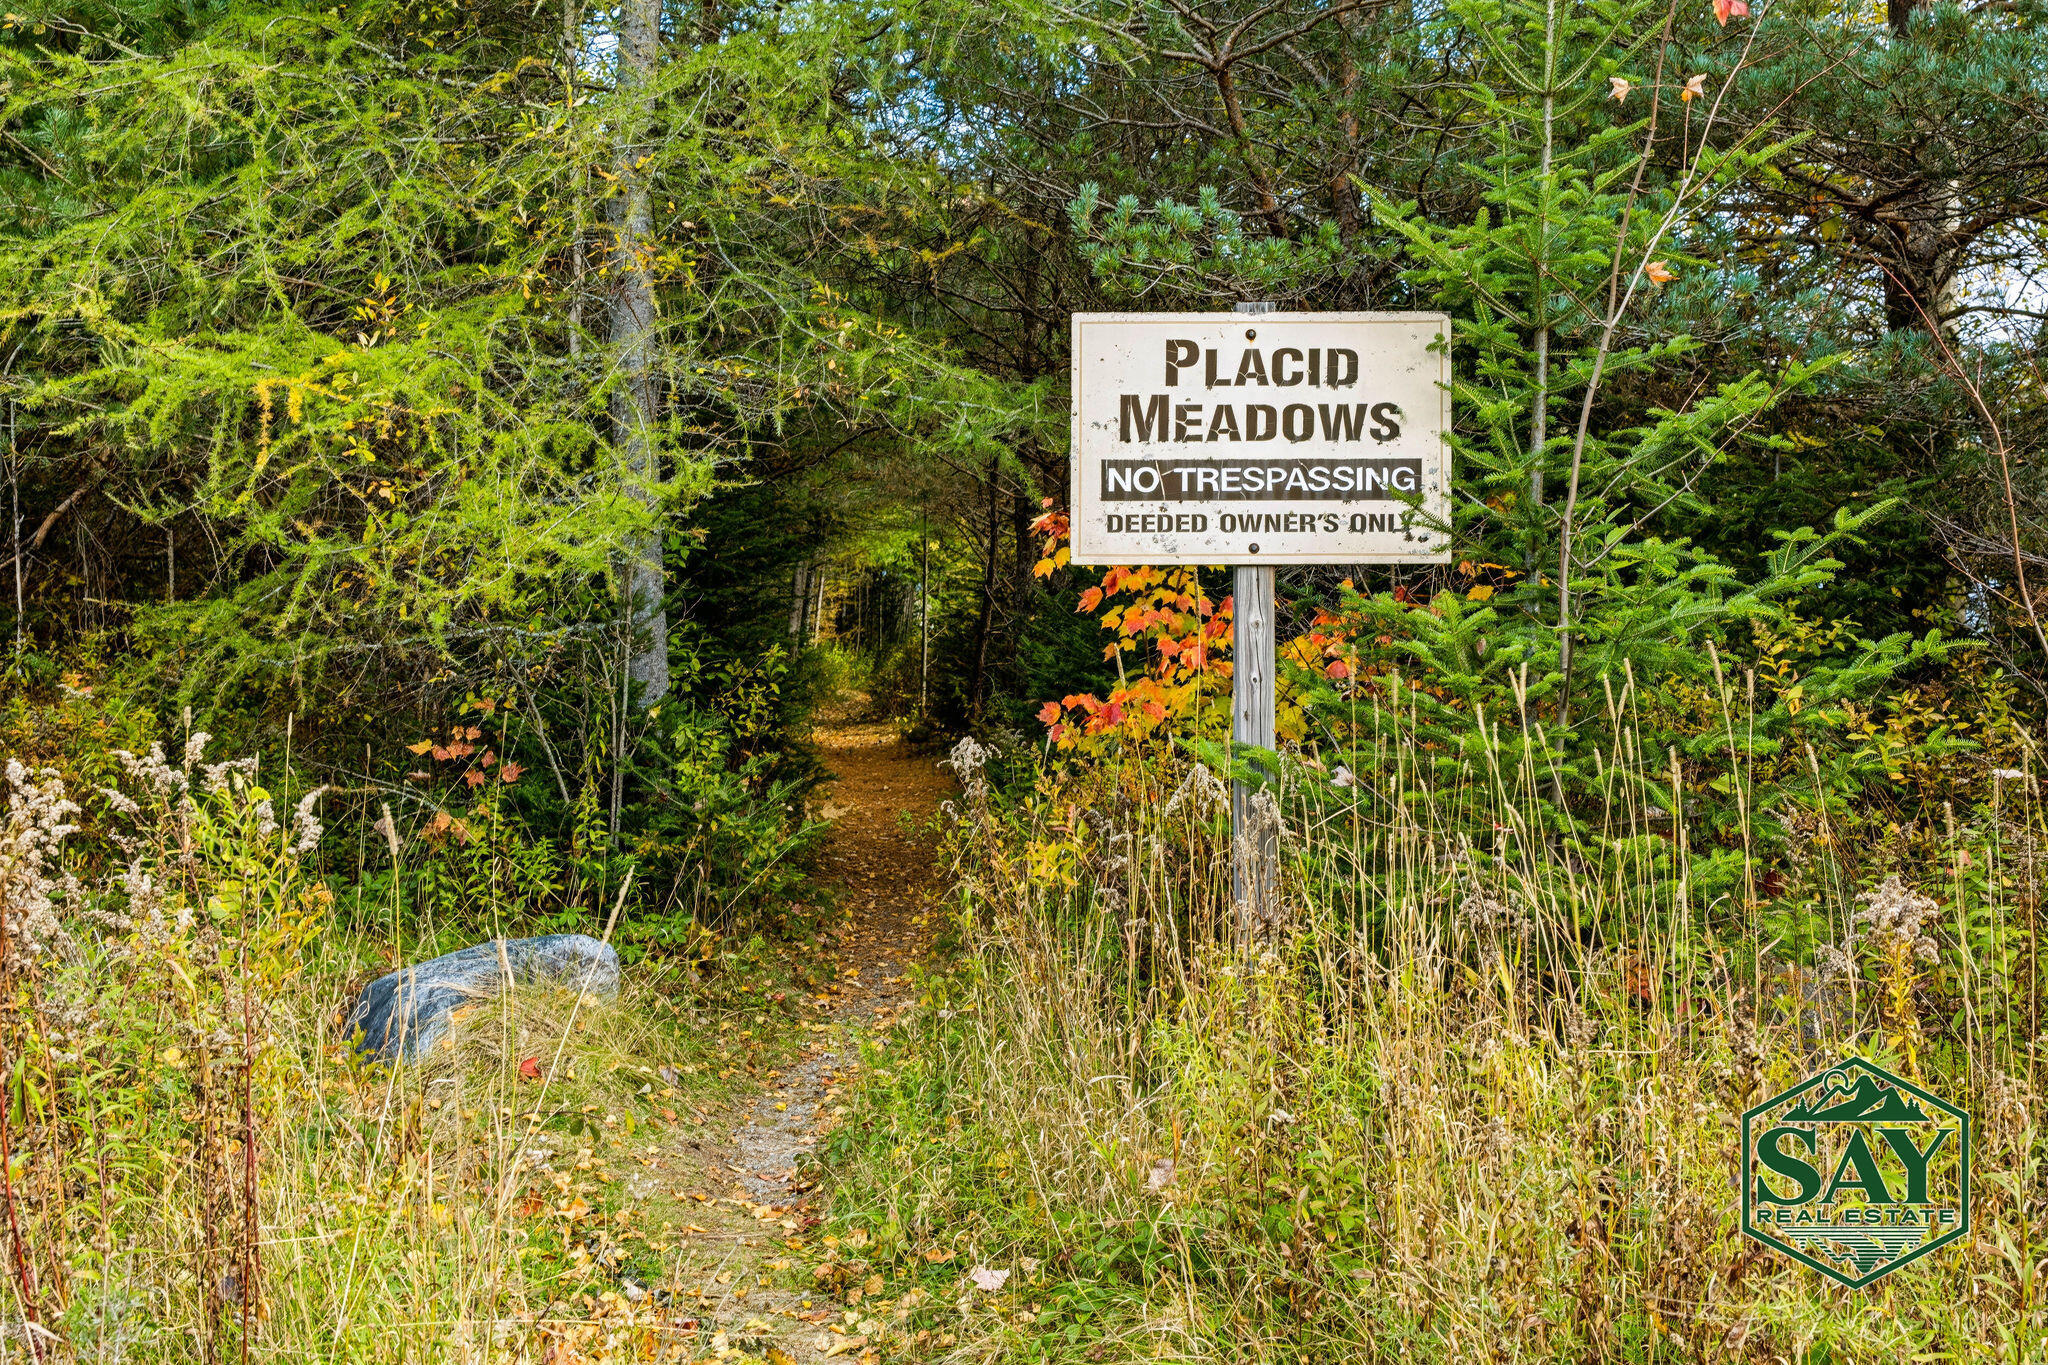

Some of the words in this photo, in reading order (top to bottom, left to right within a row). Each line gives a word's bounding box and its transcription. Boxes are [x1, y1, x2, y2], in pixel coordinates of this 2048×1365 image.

[1165, 338, 1359, 388] PLACID
[1119, 393, 1402, 442] MEADOWS
[1106, 466, 1160, 492] NO
[1173, 466, 1417, 492] TRESPASSING
[1106, 513, 1208, 533] DEEDED
[1219, 512, 1340, 533] OWNER'S
